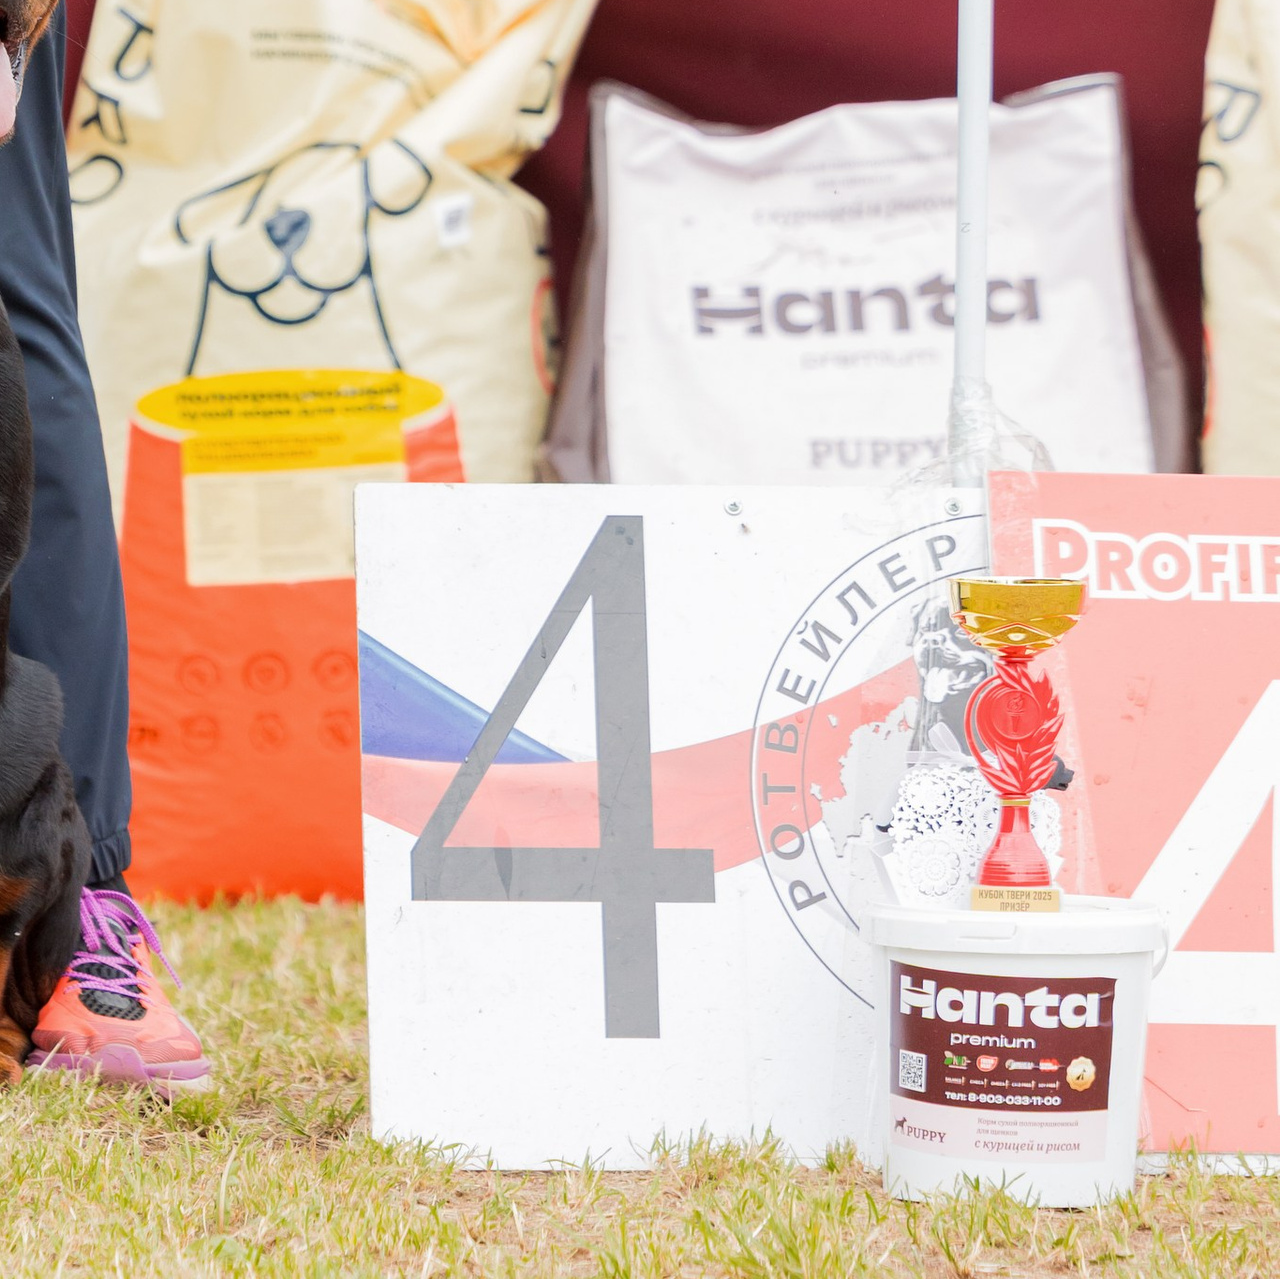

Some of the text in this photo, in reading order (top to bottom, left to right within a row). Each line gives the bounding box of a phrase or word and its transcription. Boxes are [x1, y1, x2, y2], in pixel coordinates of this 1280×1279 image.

[760, 533, 958, 912] РОТВЕЙЛЕР
[411, 514, 716, 1039] 4
[978, 889, 1052, 901] КУБОК ТВЕРИ 2025
[999, 900, 1030, 912] ПРИЗЁР
[898, 974, 1100, 1029] Hanta
[949, 1032, 1037, 1050] premium
[944, 1091, 968, 1102] тел:
[906, 1124, 947, 1144] PUPPY
[982, 1140, 1034, 1154] курицей
[1036, 1143, 1044, 1152] и
[1045, 1142, 1081, 1155] рисом
